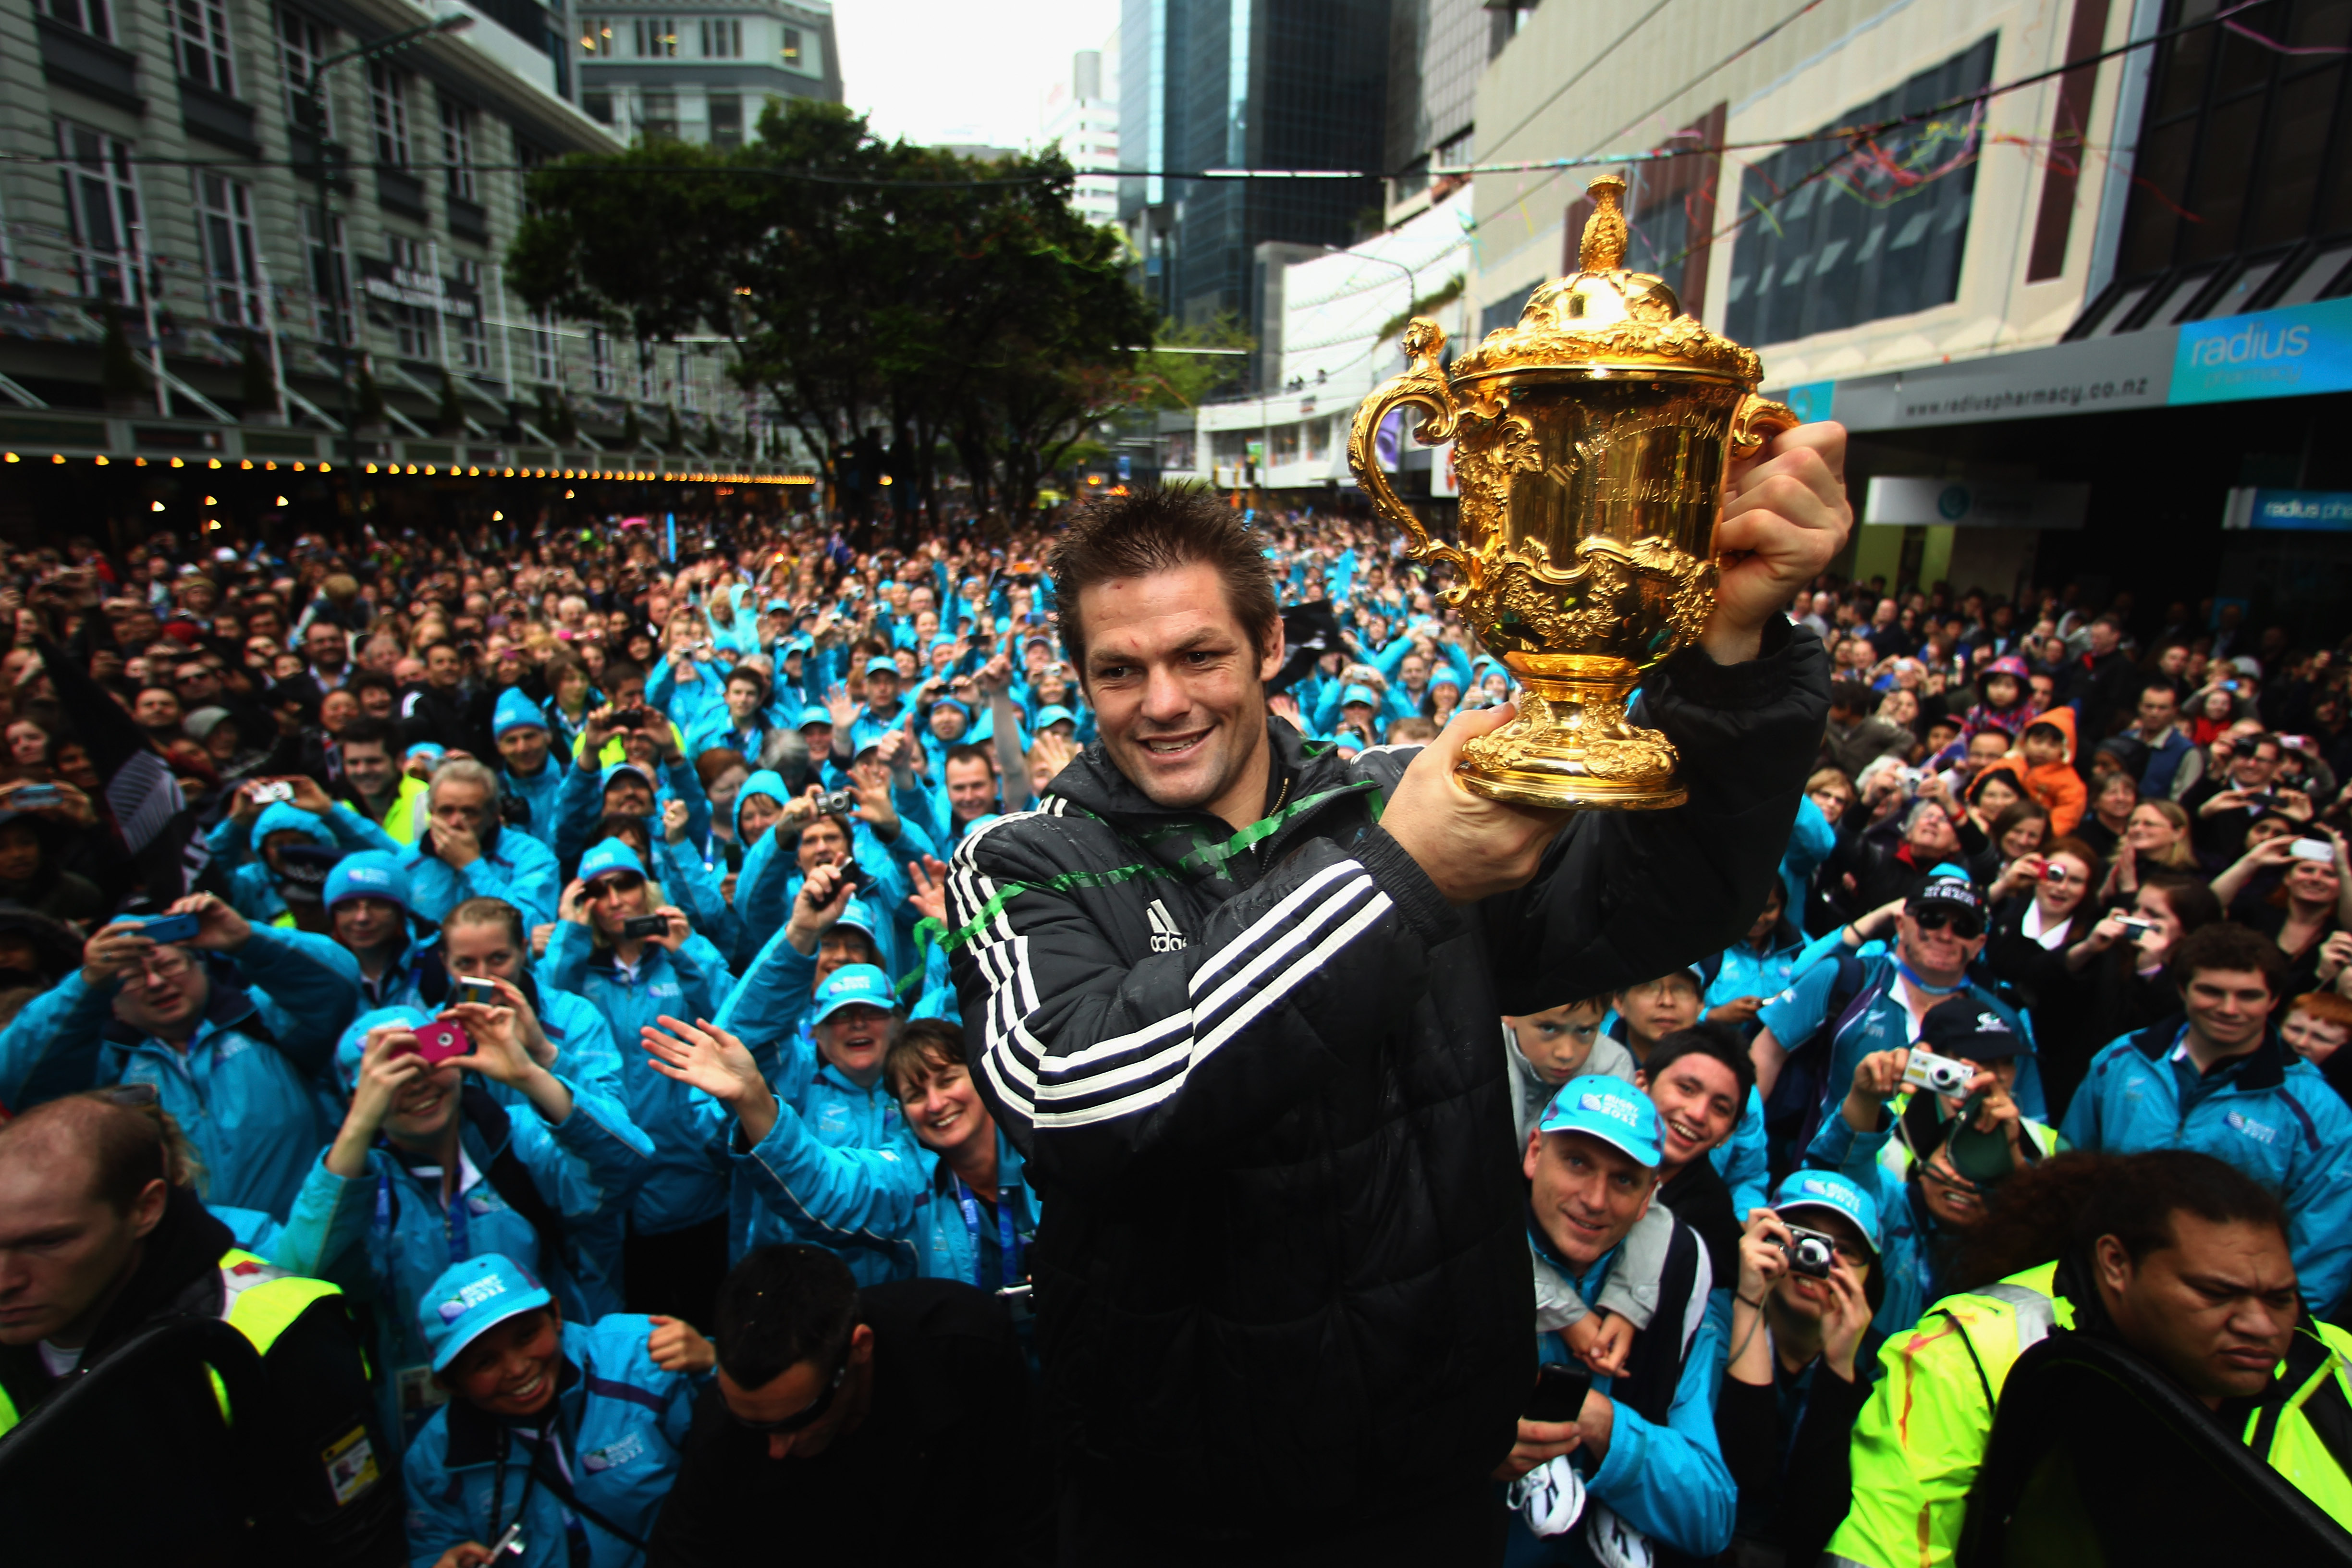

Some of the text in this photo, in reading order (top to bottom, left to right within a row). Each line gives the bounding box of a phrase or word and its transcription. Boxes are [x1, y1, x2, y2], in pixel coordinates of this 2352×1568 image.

[2191, 320, 2311, 368] radius
[1906, 377, 2149, 417] www.radiuspharmacy.co.nz
[1150, 931, 1188, 953] adas
